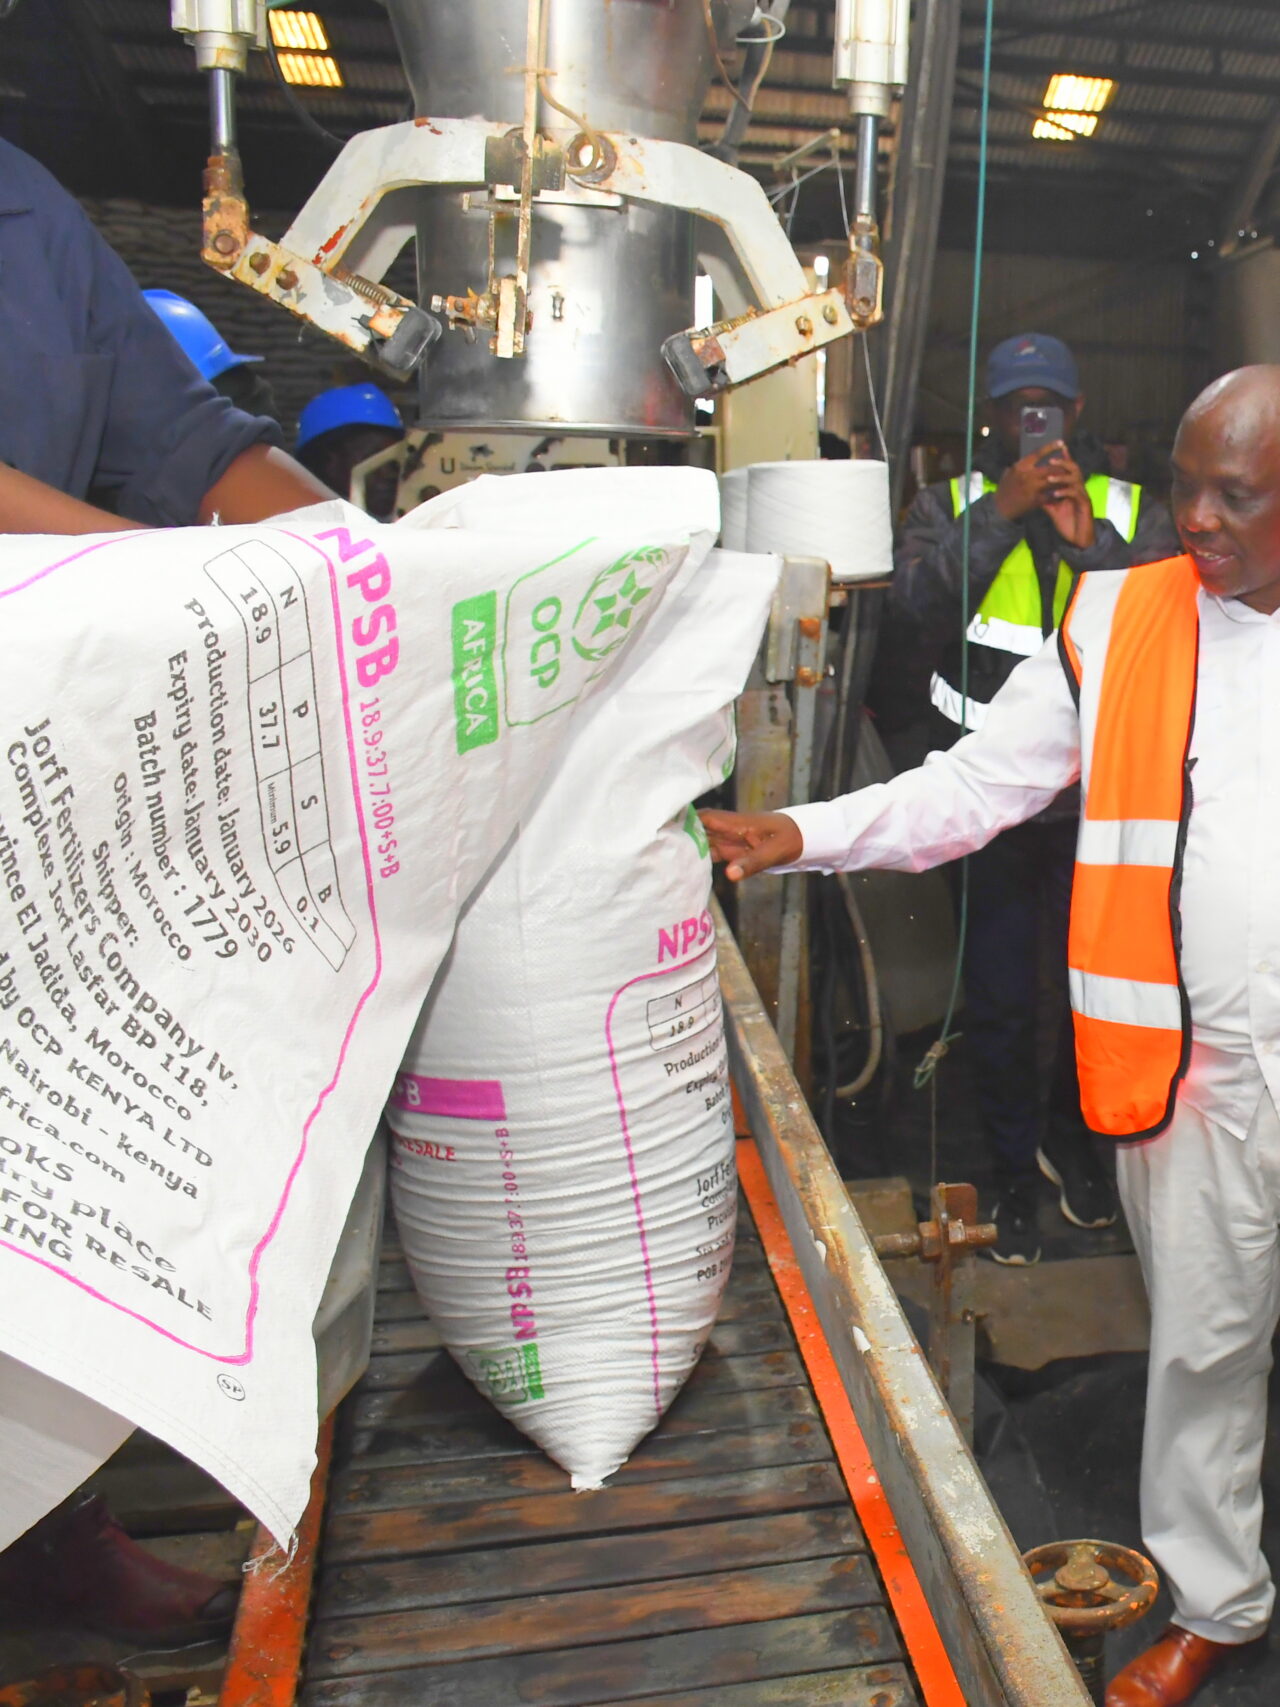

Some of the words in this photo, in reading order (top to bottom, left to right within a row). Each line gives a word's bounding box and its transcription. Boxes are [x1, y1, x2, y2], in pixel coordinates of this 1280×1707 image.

[313, 527, 399, 688] NPSB
[529, 596, 562, 688] OCP
[184, 598, 228, 745] Production
[461, 618, 487, 736] AFRICA
[134, 710, 166, 788] Batch
[213, 747, 232, 807] date:
[240, 587, 272, 644] 18.9
[259, 702, 280, 750] 37.7
[272, 821, 291, 854] 5.9
[296, 896, 319, 933] 0.1
[279, 586, 298, 609] N
[292, 702, 309, 719] P
[301, 794, 318, 811] S
[318, 884, 332, 904] B
[146, 791, 180, 880] number
[167, 649, 194, 740] Expiry
[225, 897, 272, 962] 2030
[218, 807, 256, 898] January
[24, 717, 69, 786] Jorf
[51, 784, 101, 935] Fertilizers
[99, 932, 204, 1059] Company
[92, 840, 139, 947] Shipper:
[114, 772, 135, 849] Origin
[129, 860, 192, 961] Morocco
[7, 740, 54, 880] Complexe
[49, 878, 73, 933] Jorf
[67, 932, 120, 1016] Lasfar
[120, 1013, 157, 1049] BP
[160, 1052, 208, 1107] 118,
[16, 901, 42, 935] El
[183, 894, 239, 959] 1779
[253, 895, 295, 954] 2026
[28, 932, 77, 1032] Jadida,
[0, 965, 21, 1010] by
[17, 1006, 63, 1056] OCP
[67, 1057, 155, 1131] KENYA
[163, 1127, 213, 1167] LTD
[0, 1037, 93, 1126] Nairobi
[84, 1026, 192, 1121] Morocco
[0, 1214, 73, 1263] ING
[0, 1187, 72, 1239] FOR
[85, 1233, 214, 1322] RESALE
[70, 1198, 177, 1274] place
